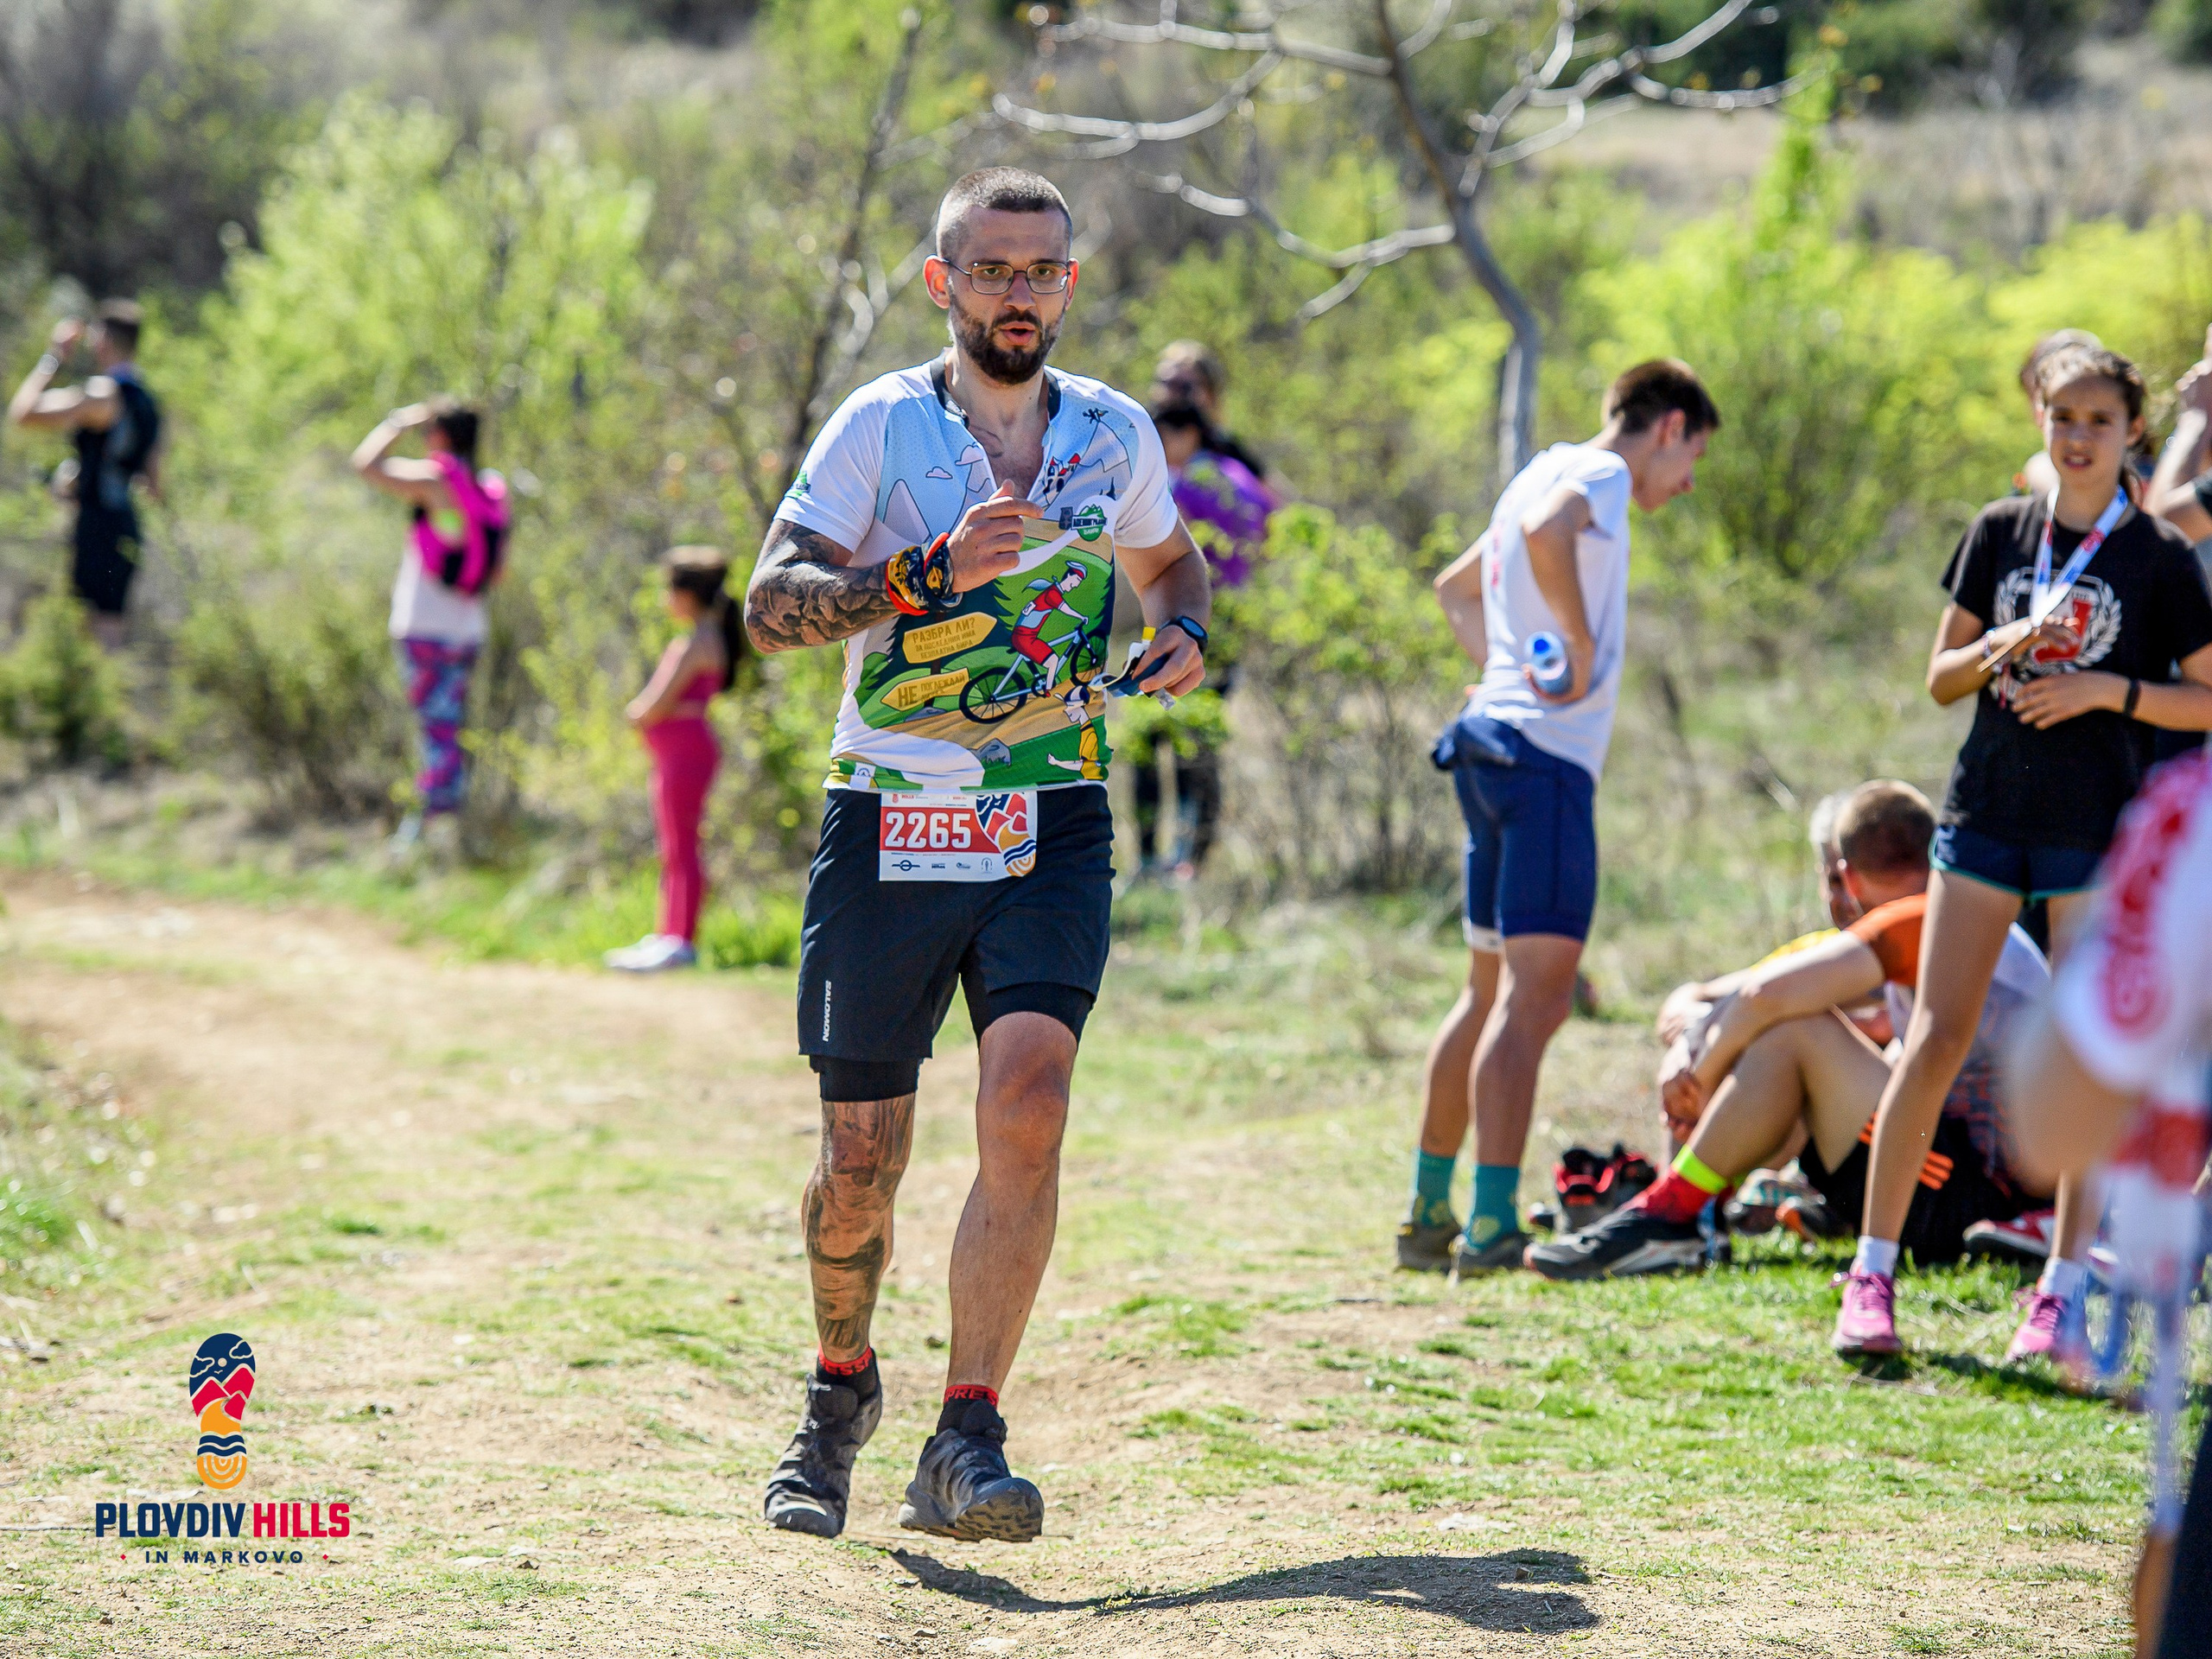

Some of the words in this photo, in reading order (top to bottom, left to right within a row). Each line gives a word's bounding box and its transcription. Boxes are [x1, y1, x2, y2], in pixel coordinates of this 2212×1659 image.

[912, 625, 952, 644] РАЗБРА
[956, 617, 976, 632] ЛИ?
[898, 685, 918, 708] НЕ
[885, 811, 971, 849] 2265
[823, 980, 832, 1042] SALOMON
